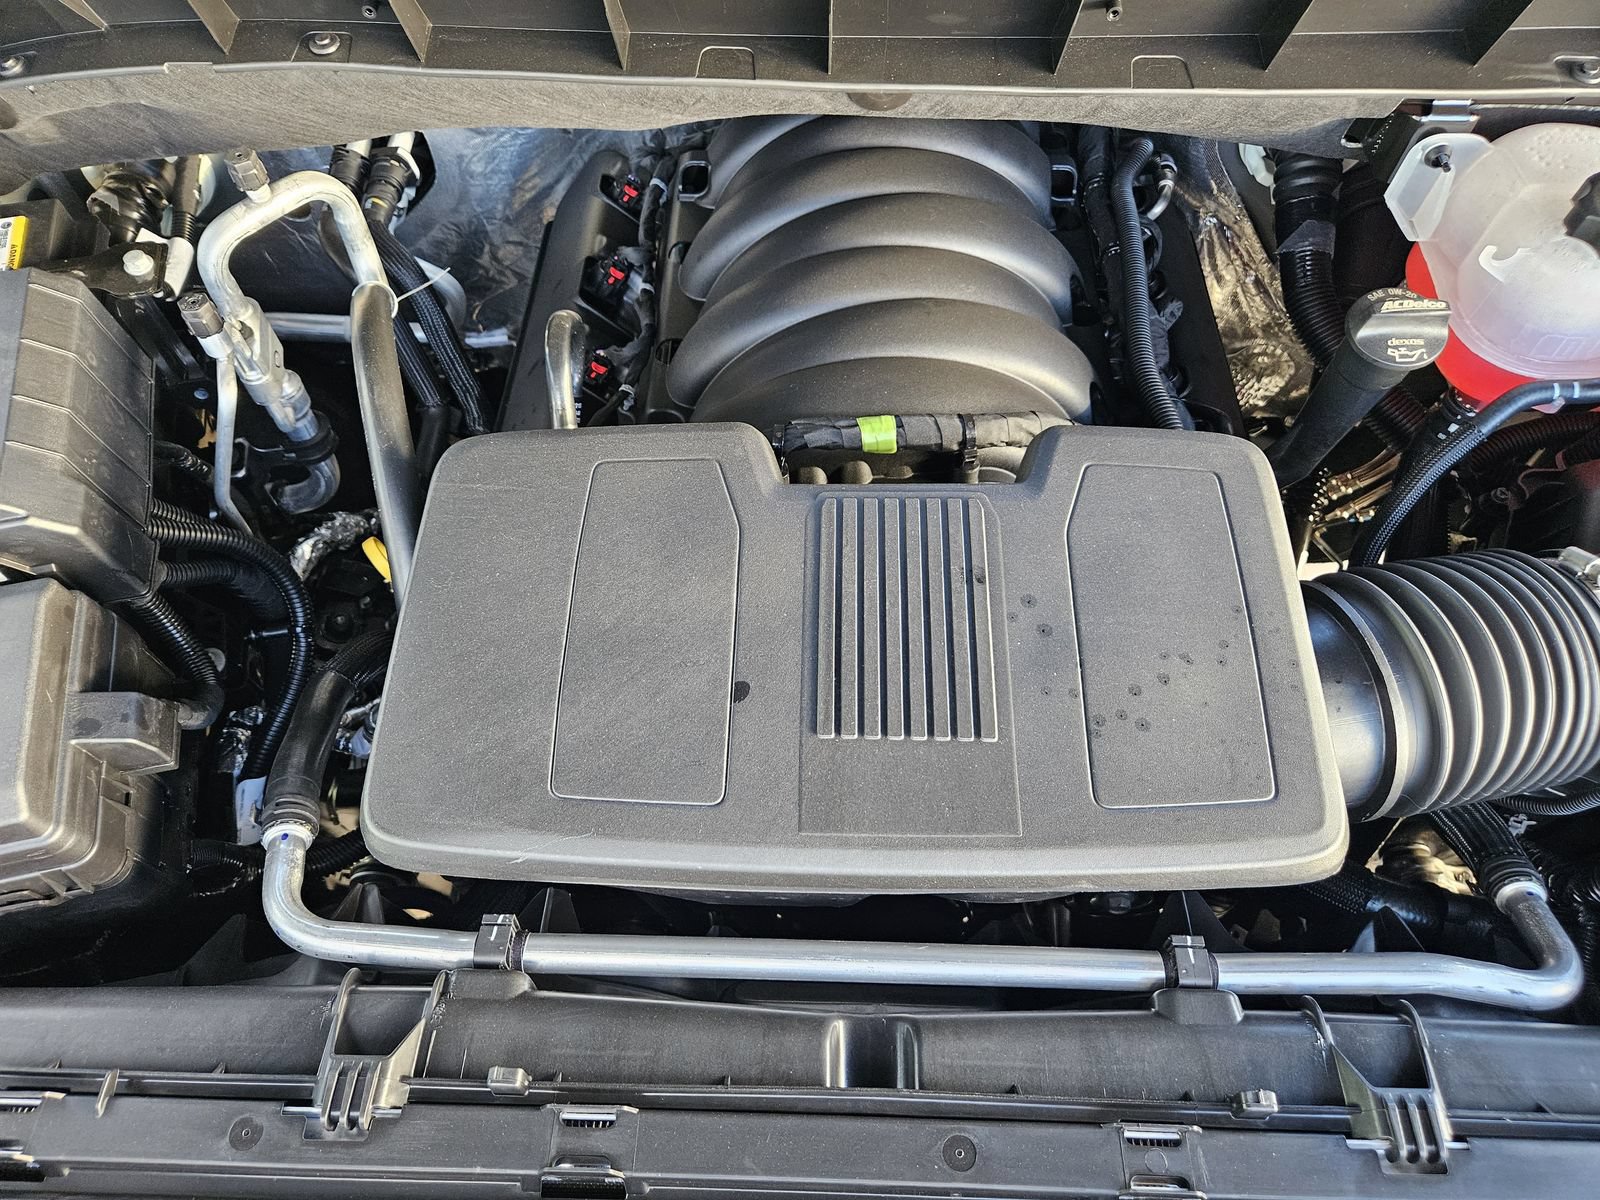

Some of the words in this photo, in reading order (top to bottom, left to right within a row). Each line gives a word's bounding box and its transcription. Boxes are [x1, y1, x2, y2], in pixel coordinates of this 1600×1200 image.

[1367, 289, 1386, 302] SAE
[1388, 288, 1418, 299] 0W-20
[1380, 298, 1448, 312] ACDelco
[1387, 337, 1425, 346] dexos
